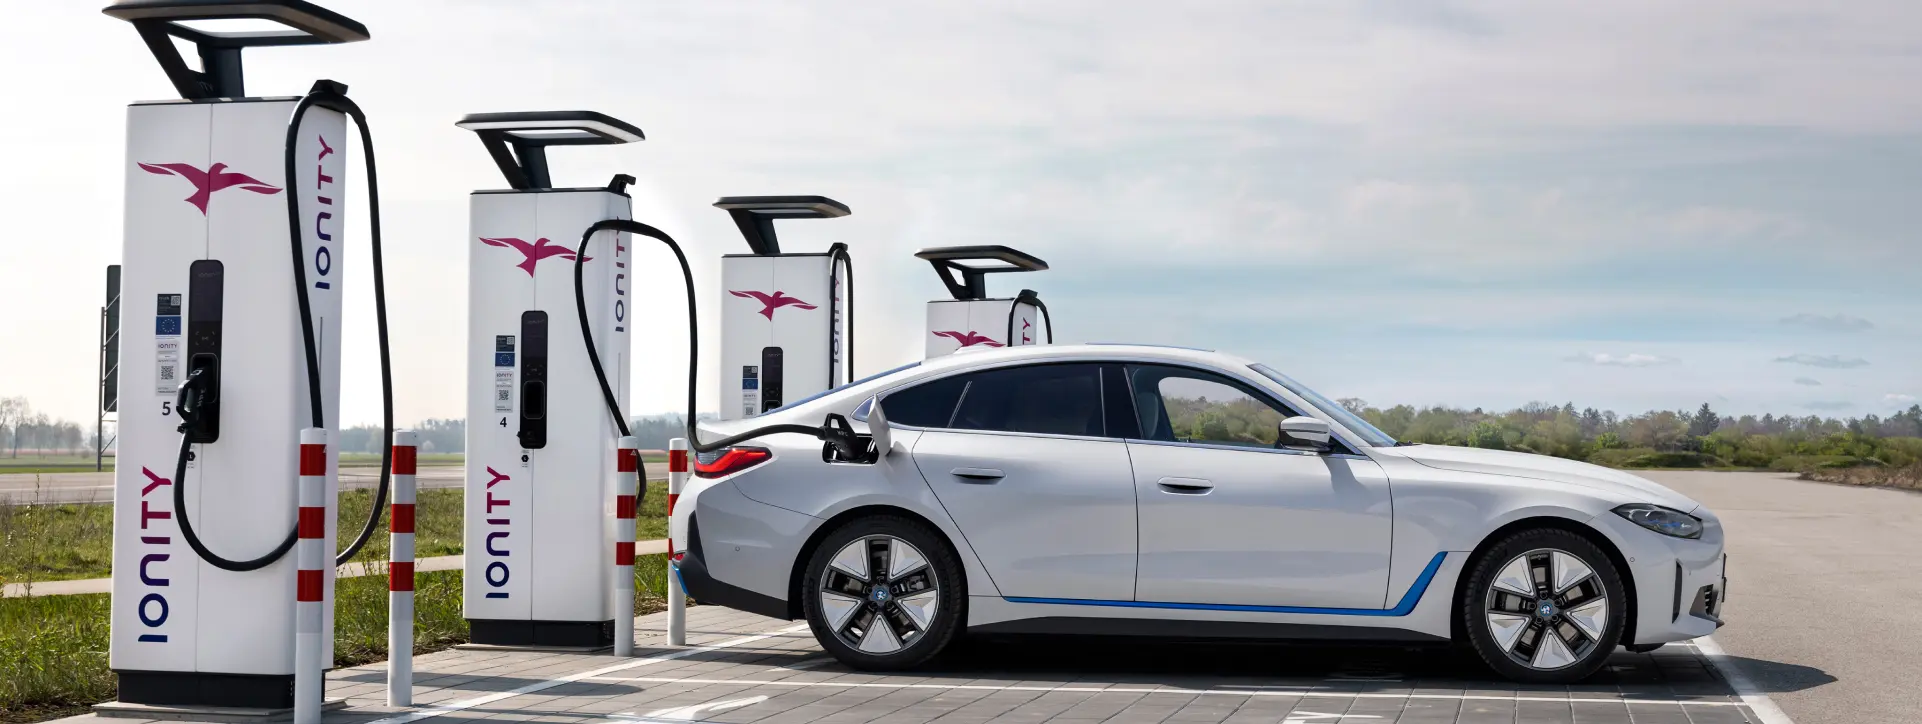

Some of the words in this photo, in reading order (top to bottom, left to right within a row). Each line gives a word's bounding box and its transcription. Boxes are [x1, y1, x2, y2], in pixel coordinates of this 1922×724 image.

[315, 134, 334, 290] IONITY
[162, 401, 171, 416] 5
[499, 416, 508, 428] 4
[138, 465, 172, 643] IONITY
[485, 465, 511, 599] IONITY
